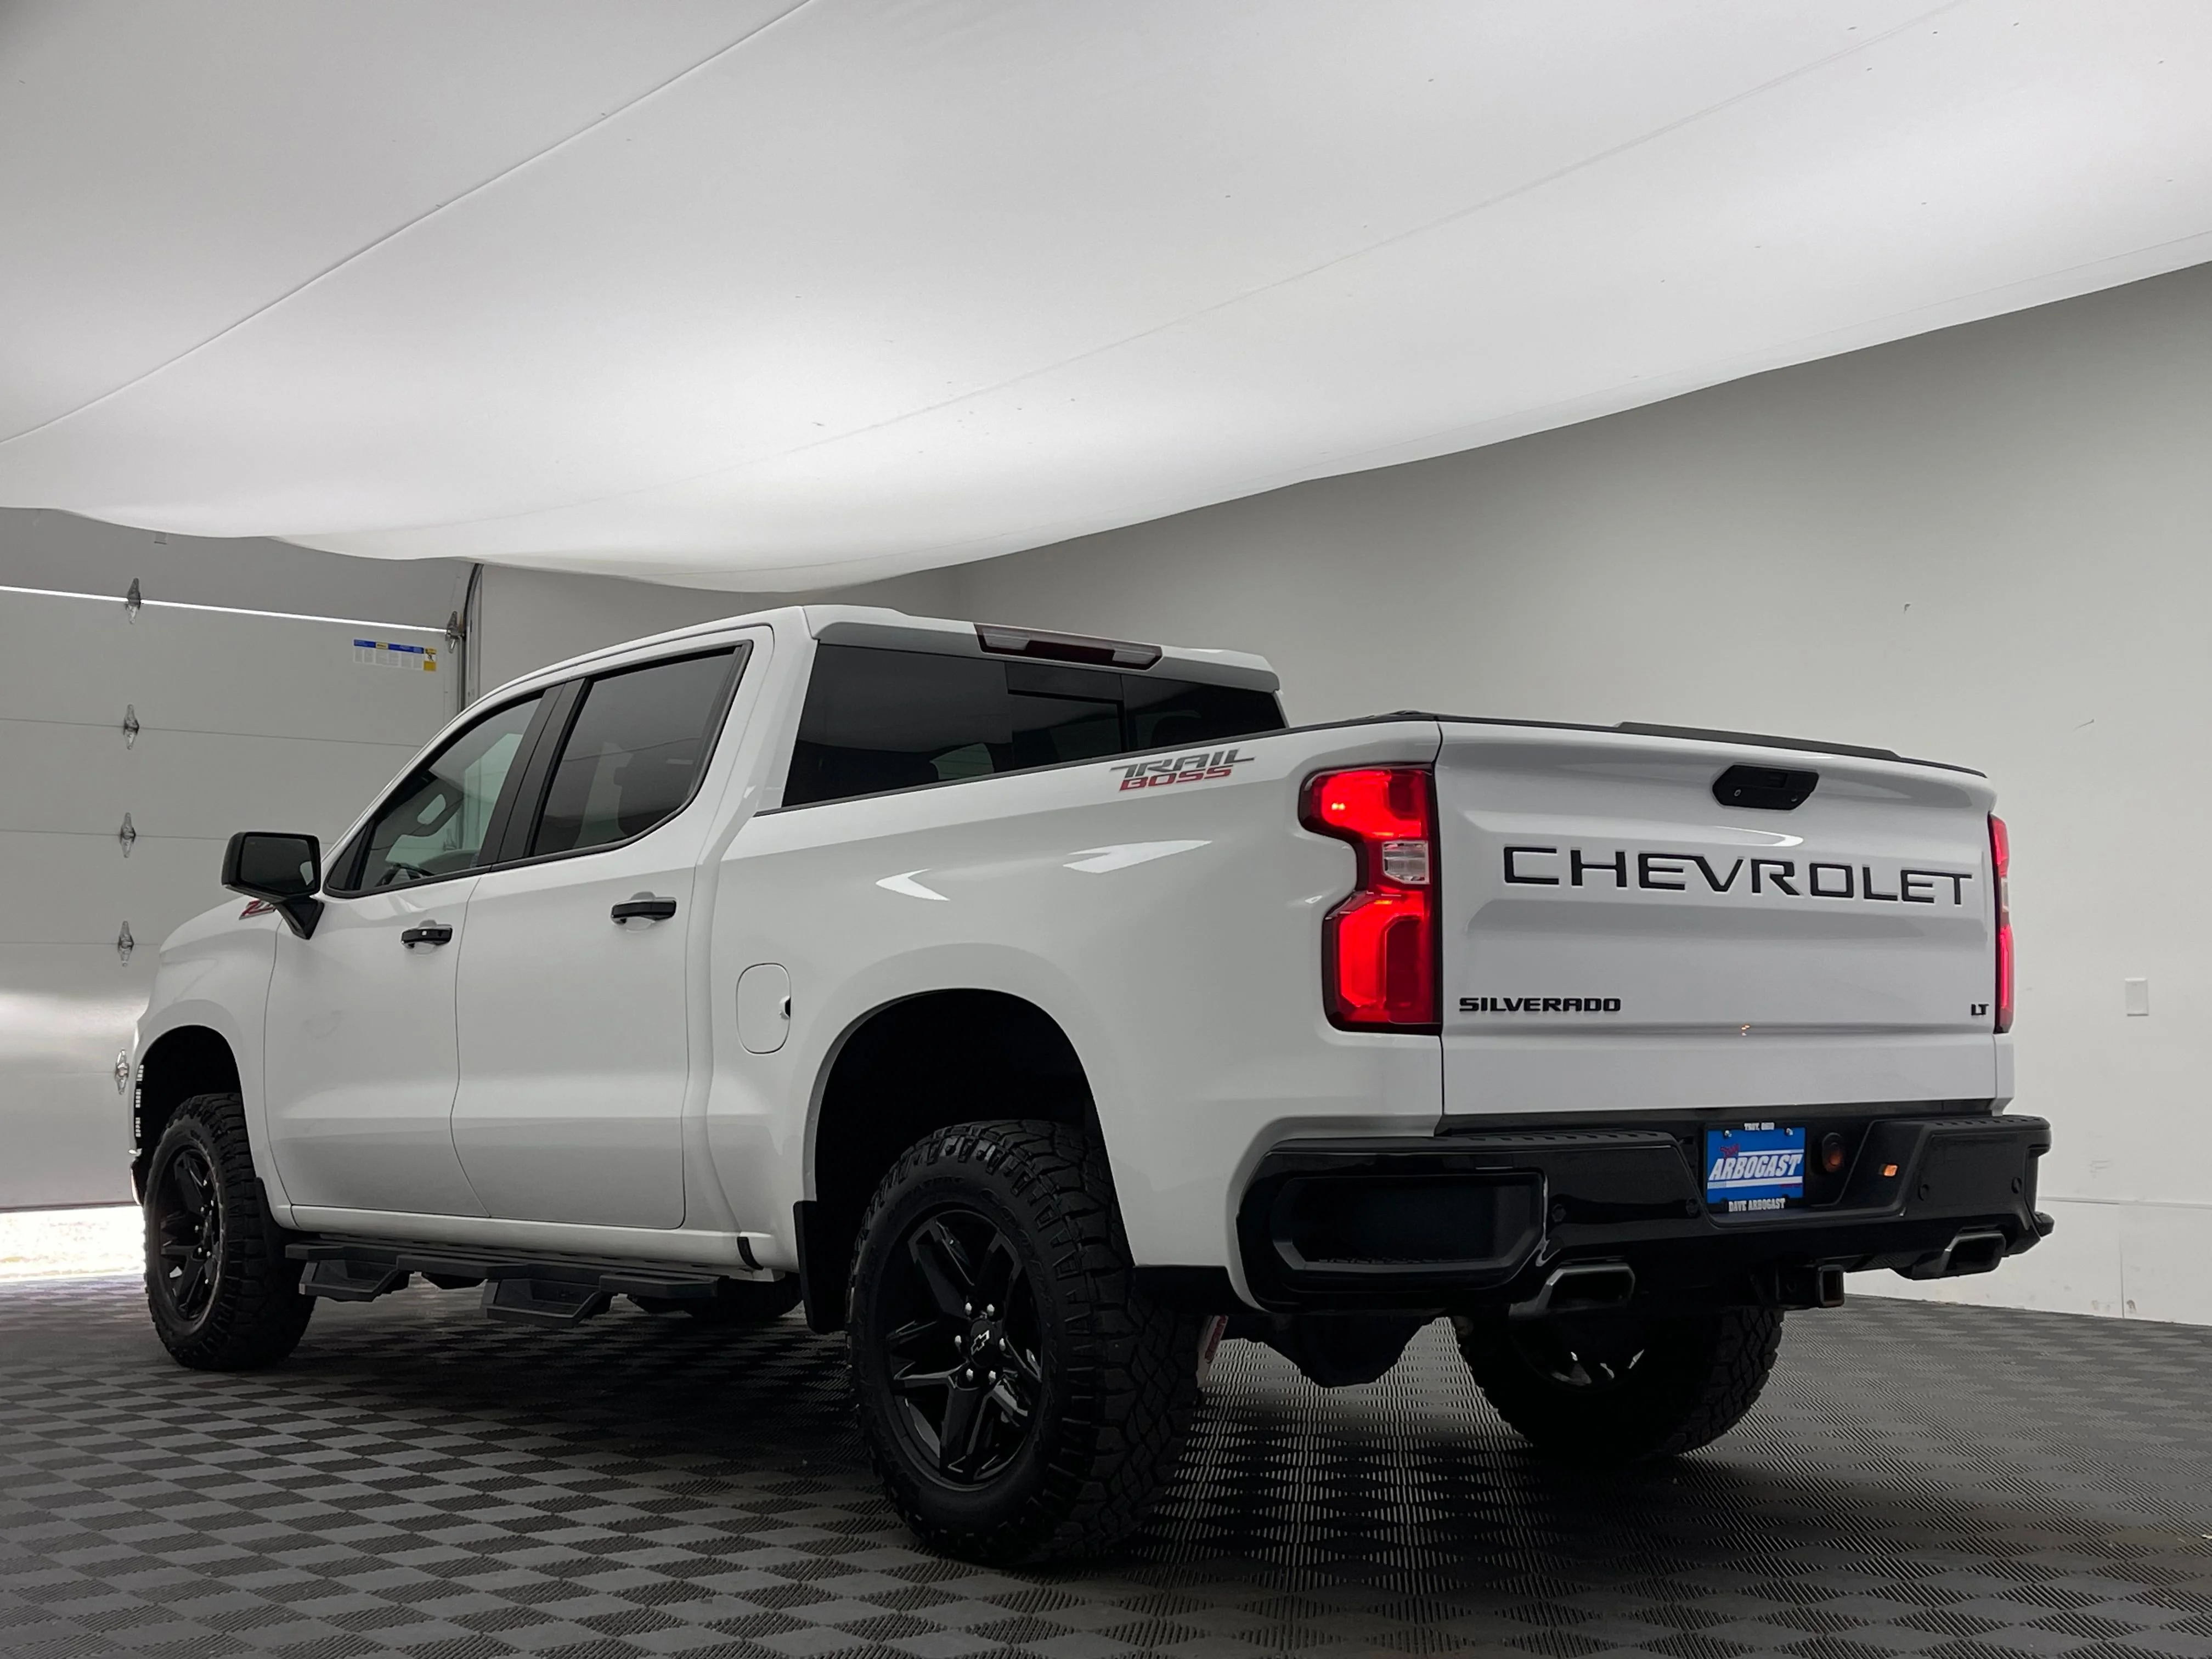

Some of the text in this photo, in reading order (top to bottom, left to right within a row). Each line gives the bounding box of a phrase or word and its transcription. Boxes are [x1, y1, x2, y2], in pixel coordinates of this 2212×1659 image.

[1109, 747, 1256, 778] TRAIL
[1119, 764, 1233, 791] BOSS
[1503, 845, 1973, 905] CHEVROLET
[1459, 997, 1621, 1012] SILVERADO
[1971, 1003, 1989, 1016] LT
[1708, 1154, 1803, 1181] ARBOGAST
[1729, 1198, 1786, 1212] DAVE ARBOGAST
